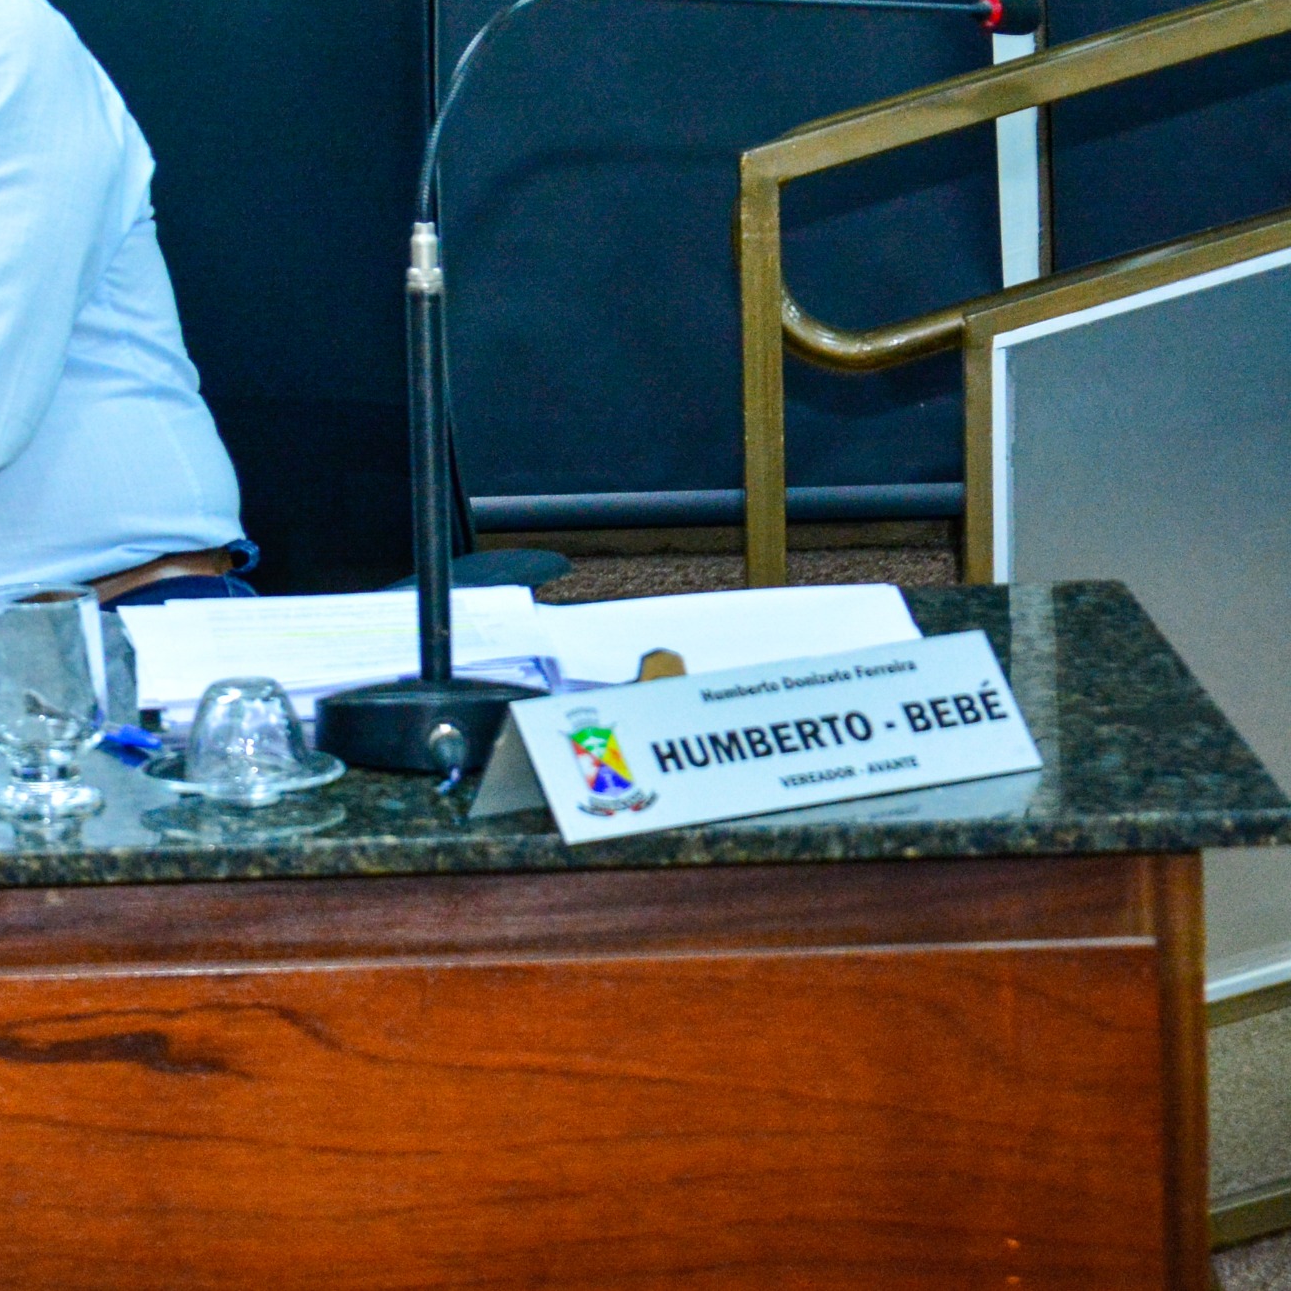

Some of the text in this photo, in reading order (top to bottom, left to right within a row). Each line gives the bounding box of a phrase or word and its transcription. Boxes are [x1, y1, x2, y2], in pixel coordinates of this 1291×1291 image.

[700, 682, 781, 703] Humberto
[855, 659, 918, 680] Ferreira
[650, 711, 874, 774] HUMBERTO
[902, 681, 1009, 733] BEBÉ
[779, 765, 856, 788] VEREADOR
[868, 756, 919, 775] AVANTE
